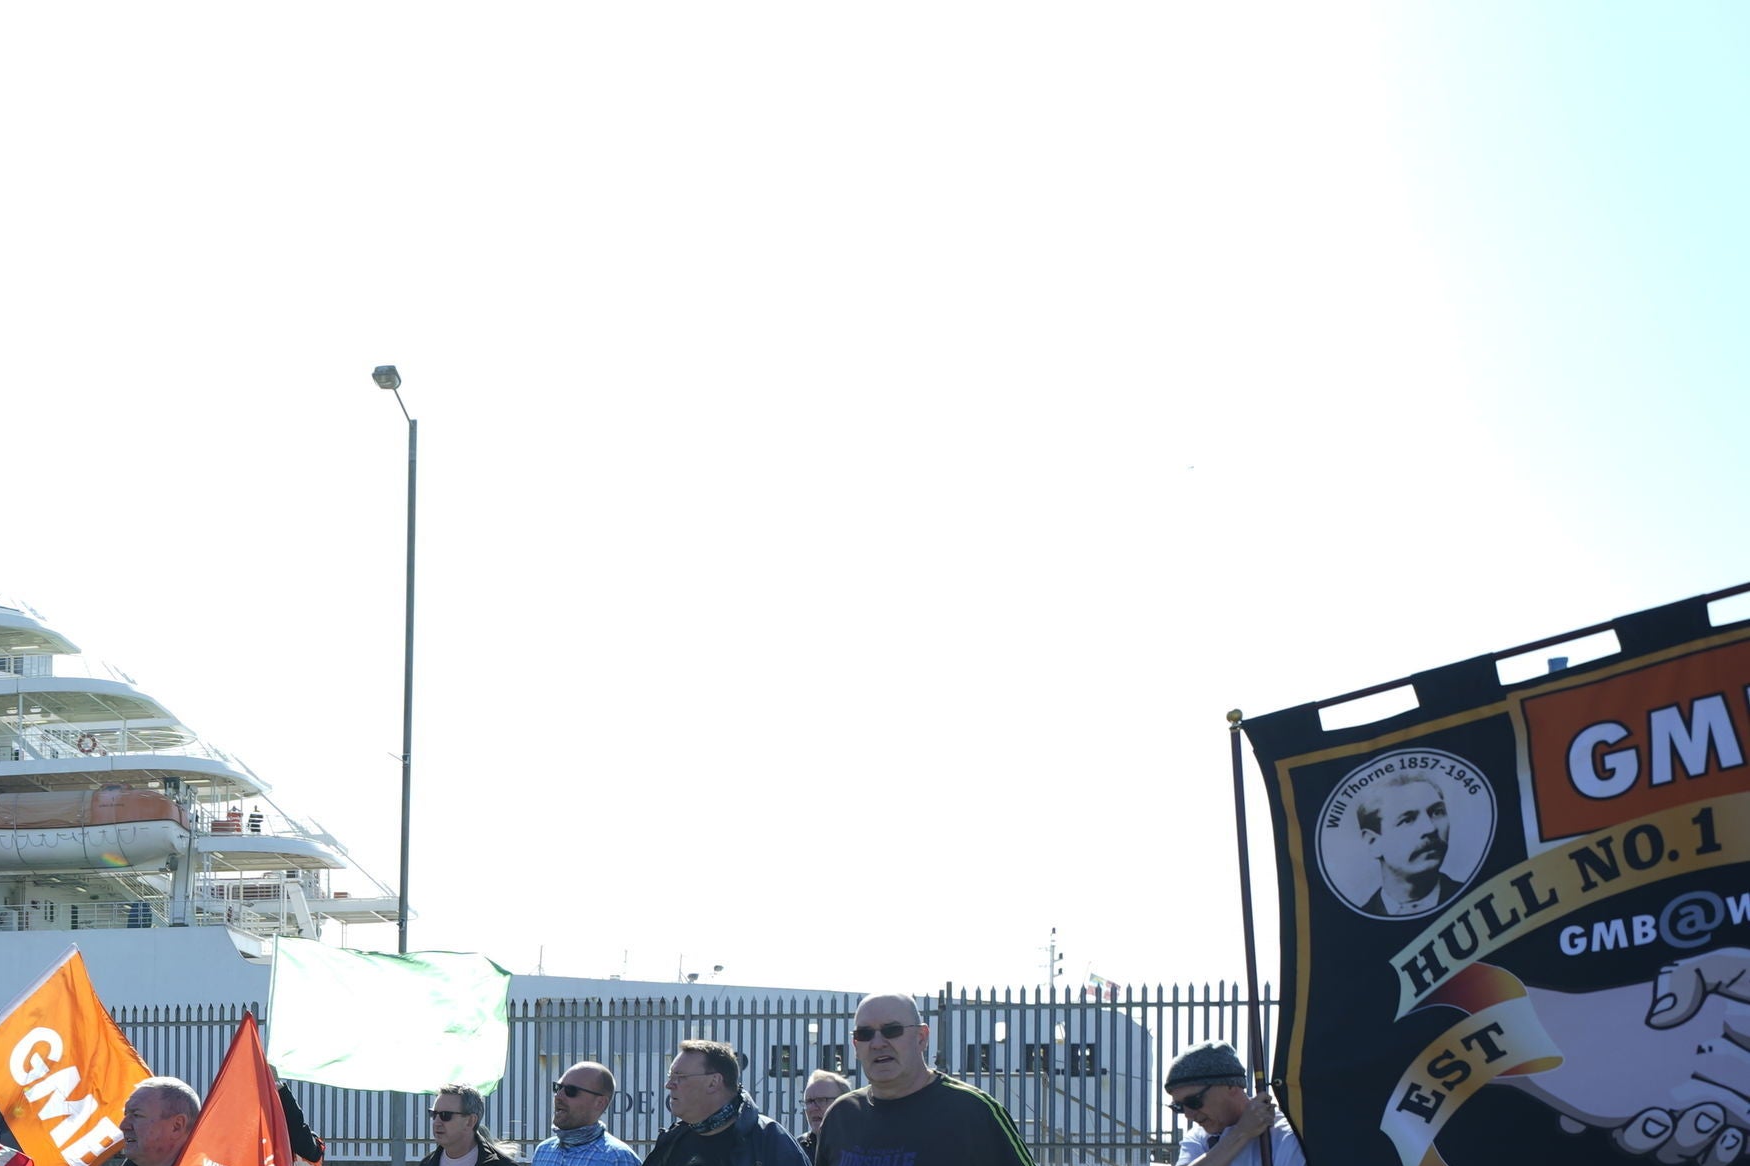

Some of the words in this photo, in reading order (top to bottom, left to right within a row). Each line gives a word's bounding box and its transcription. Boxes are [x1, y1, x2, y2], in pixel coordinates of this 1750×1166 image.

[1326, 800, 1347, 829] Will
[1341, 763, 1396, 800] Thorne
[1399, 757, 1482, 796] 1857-1946
[1568, 688, 1750, 799] GM
[1401, 871, 1559, 999] HULL
[1692, 807, 1723, 855] 1
[1396, 1022, 1508, 1125] EST
